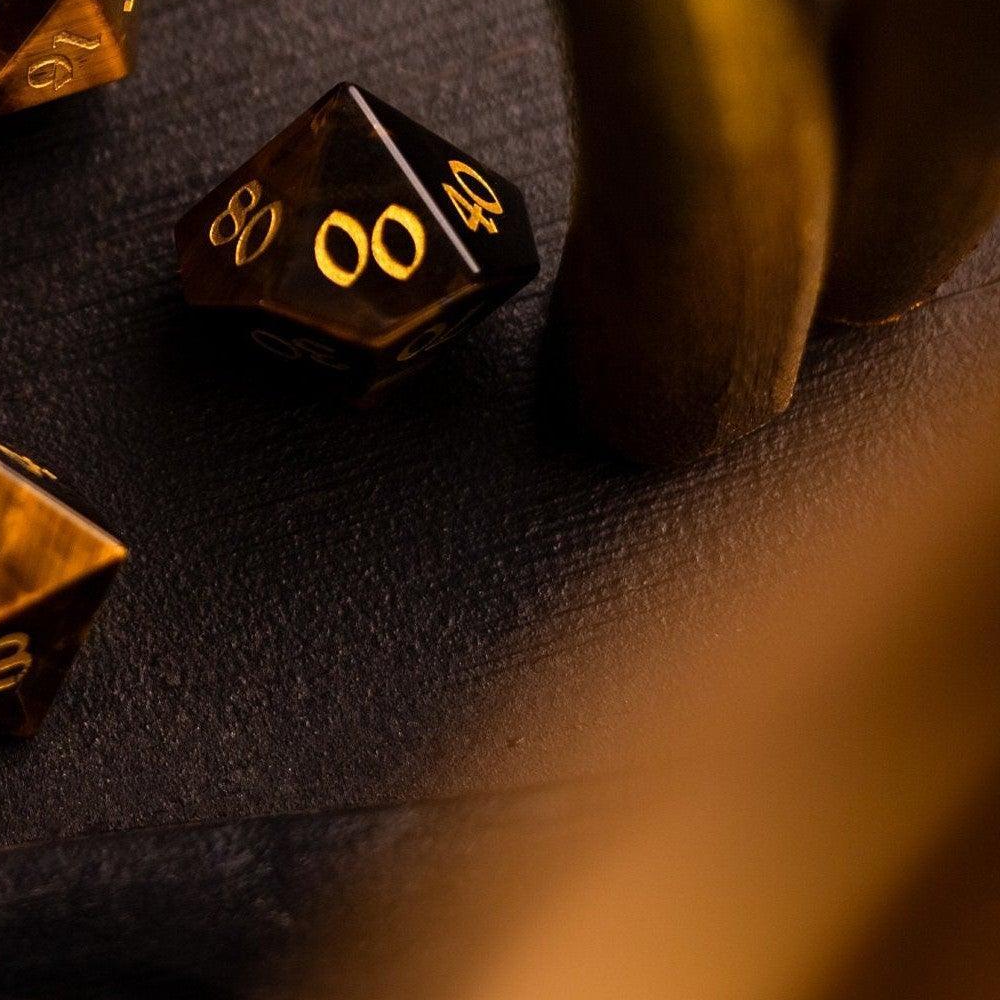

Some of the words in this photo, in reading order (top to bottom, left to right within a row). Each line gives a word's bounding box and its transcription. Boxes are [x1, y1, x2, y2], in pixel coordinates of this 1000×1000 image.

[209, 180, 283, 267] 80
[441, 160, 505, 234] 40
[313, 203, 428, 289] 00
